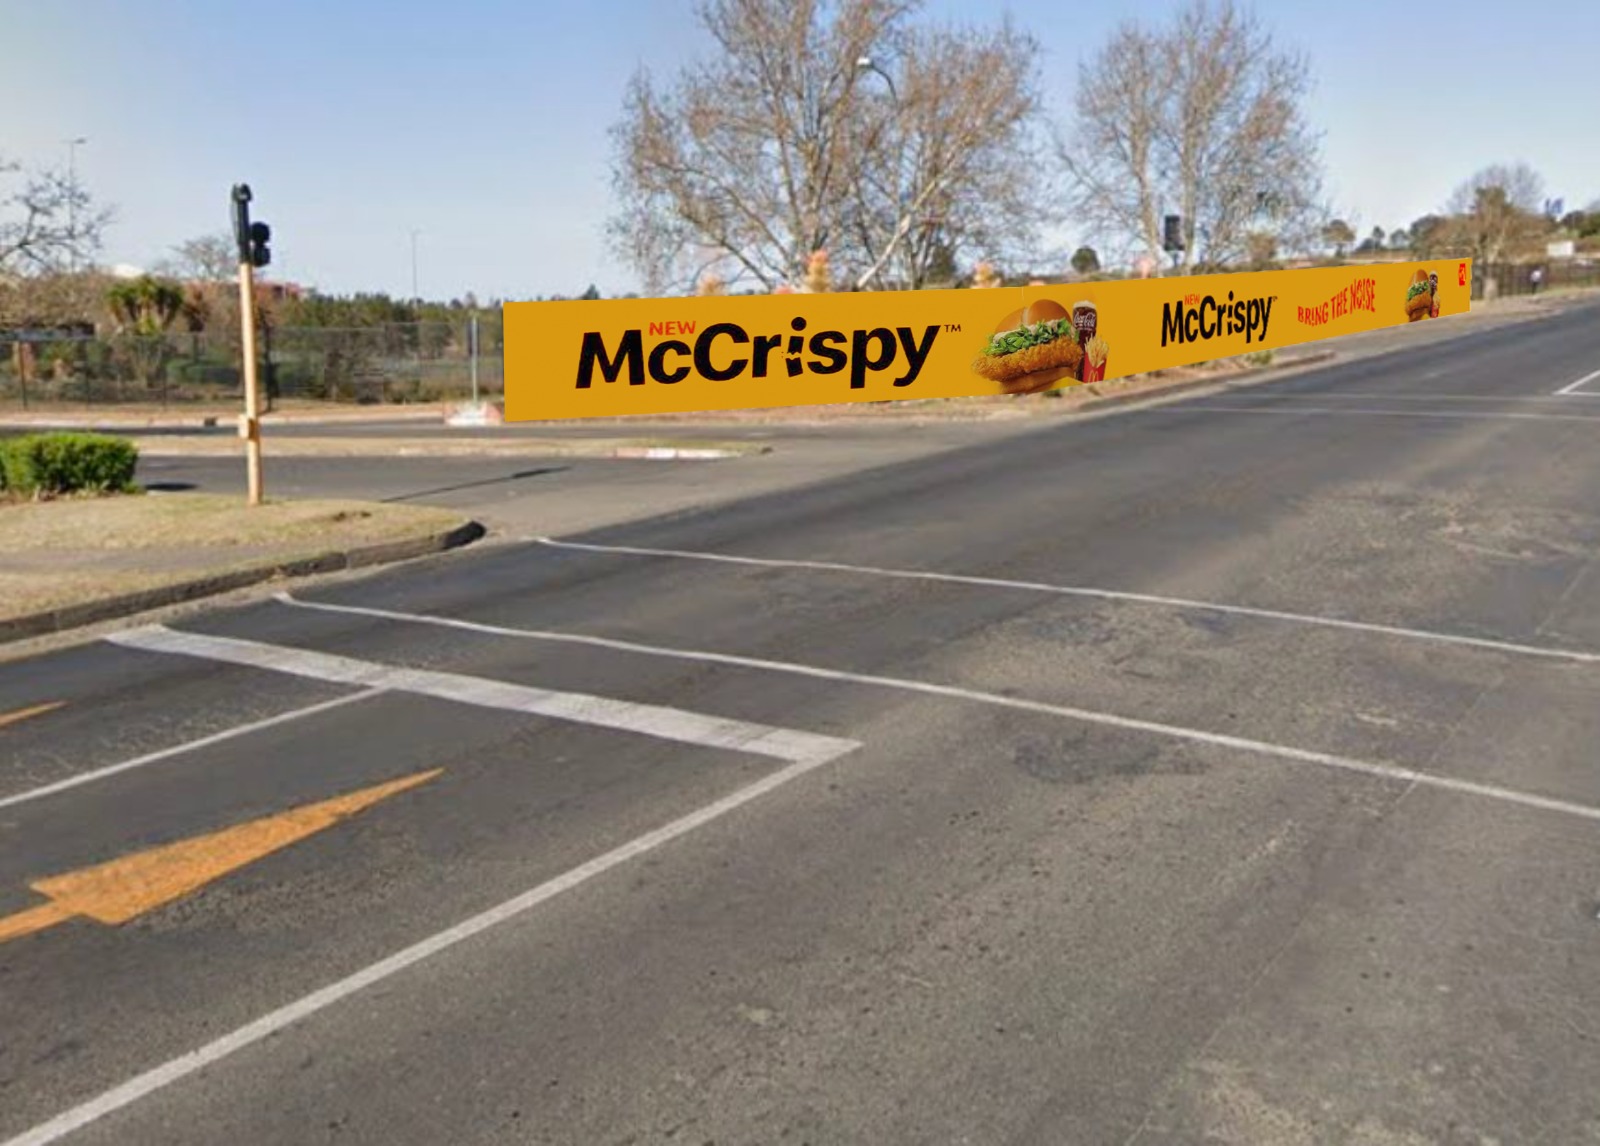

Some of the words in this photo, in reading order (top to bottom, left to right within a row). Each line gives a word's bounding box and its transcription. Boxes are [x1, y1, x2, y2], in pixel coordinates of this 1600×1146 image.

[1184, 294, 1200, 306] NEW
[1297, 301, 1329, 327] BRING
[1330, 287, 1348, 320] THE
[1349, 277, 1376, 314] NOISE
[648, 320, 697, 337] NEW
